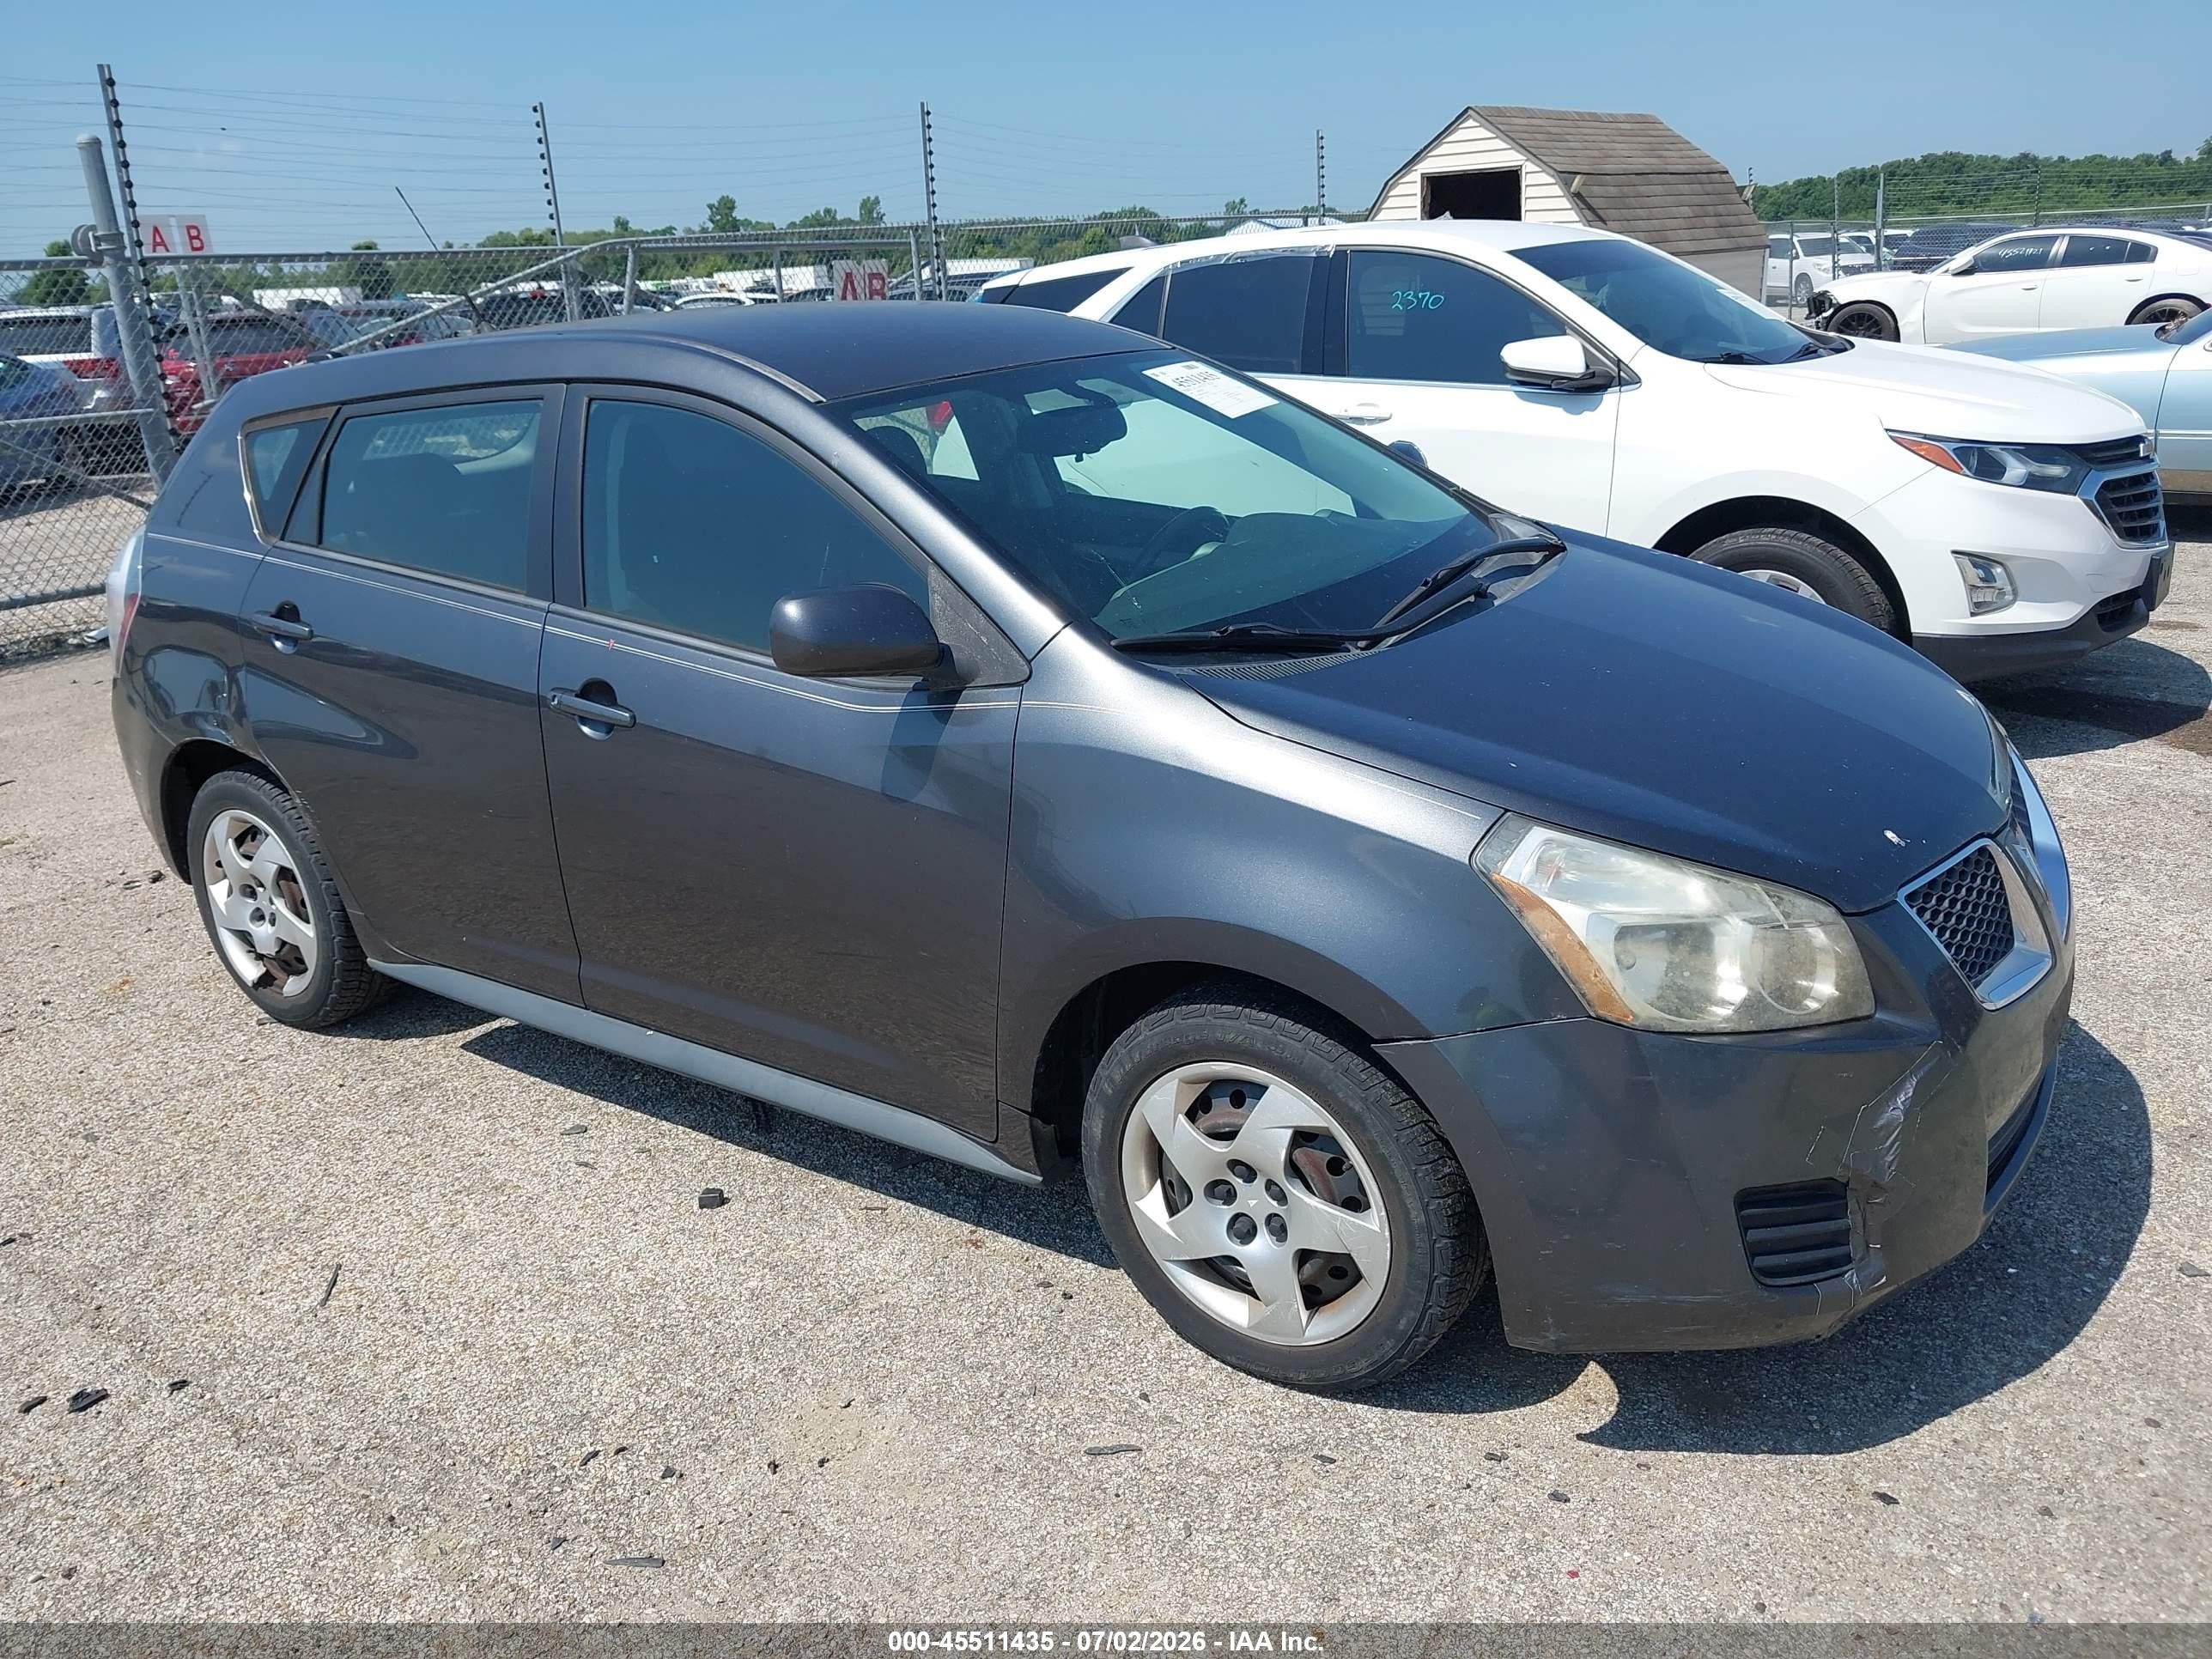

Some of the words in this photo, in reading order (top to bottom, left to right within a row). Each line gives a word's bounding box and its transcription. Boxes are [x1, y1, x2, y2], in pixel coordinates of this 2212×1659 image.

[151, 225, 170, 253] A
[185, 225, 205, 252] B
[1391, 290, 1444, 310] 2370
